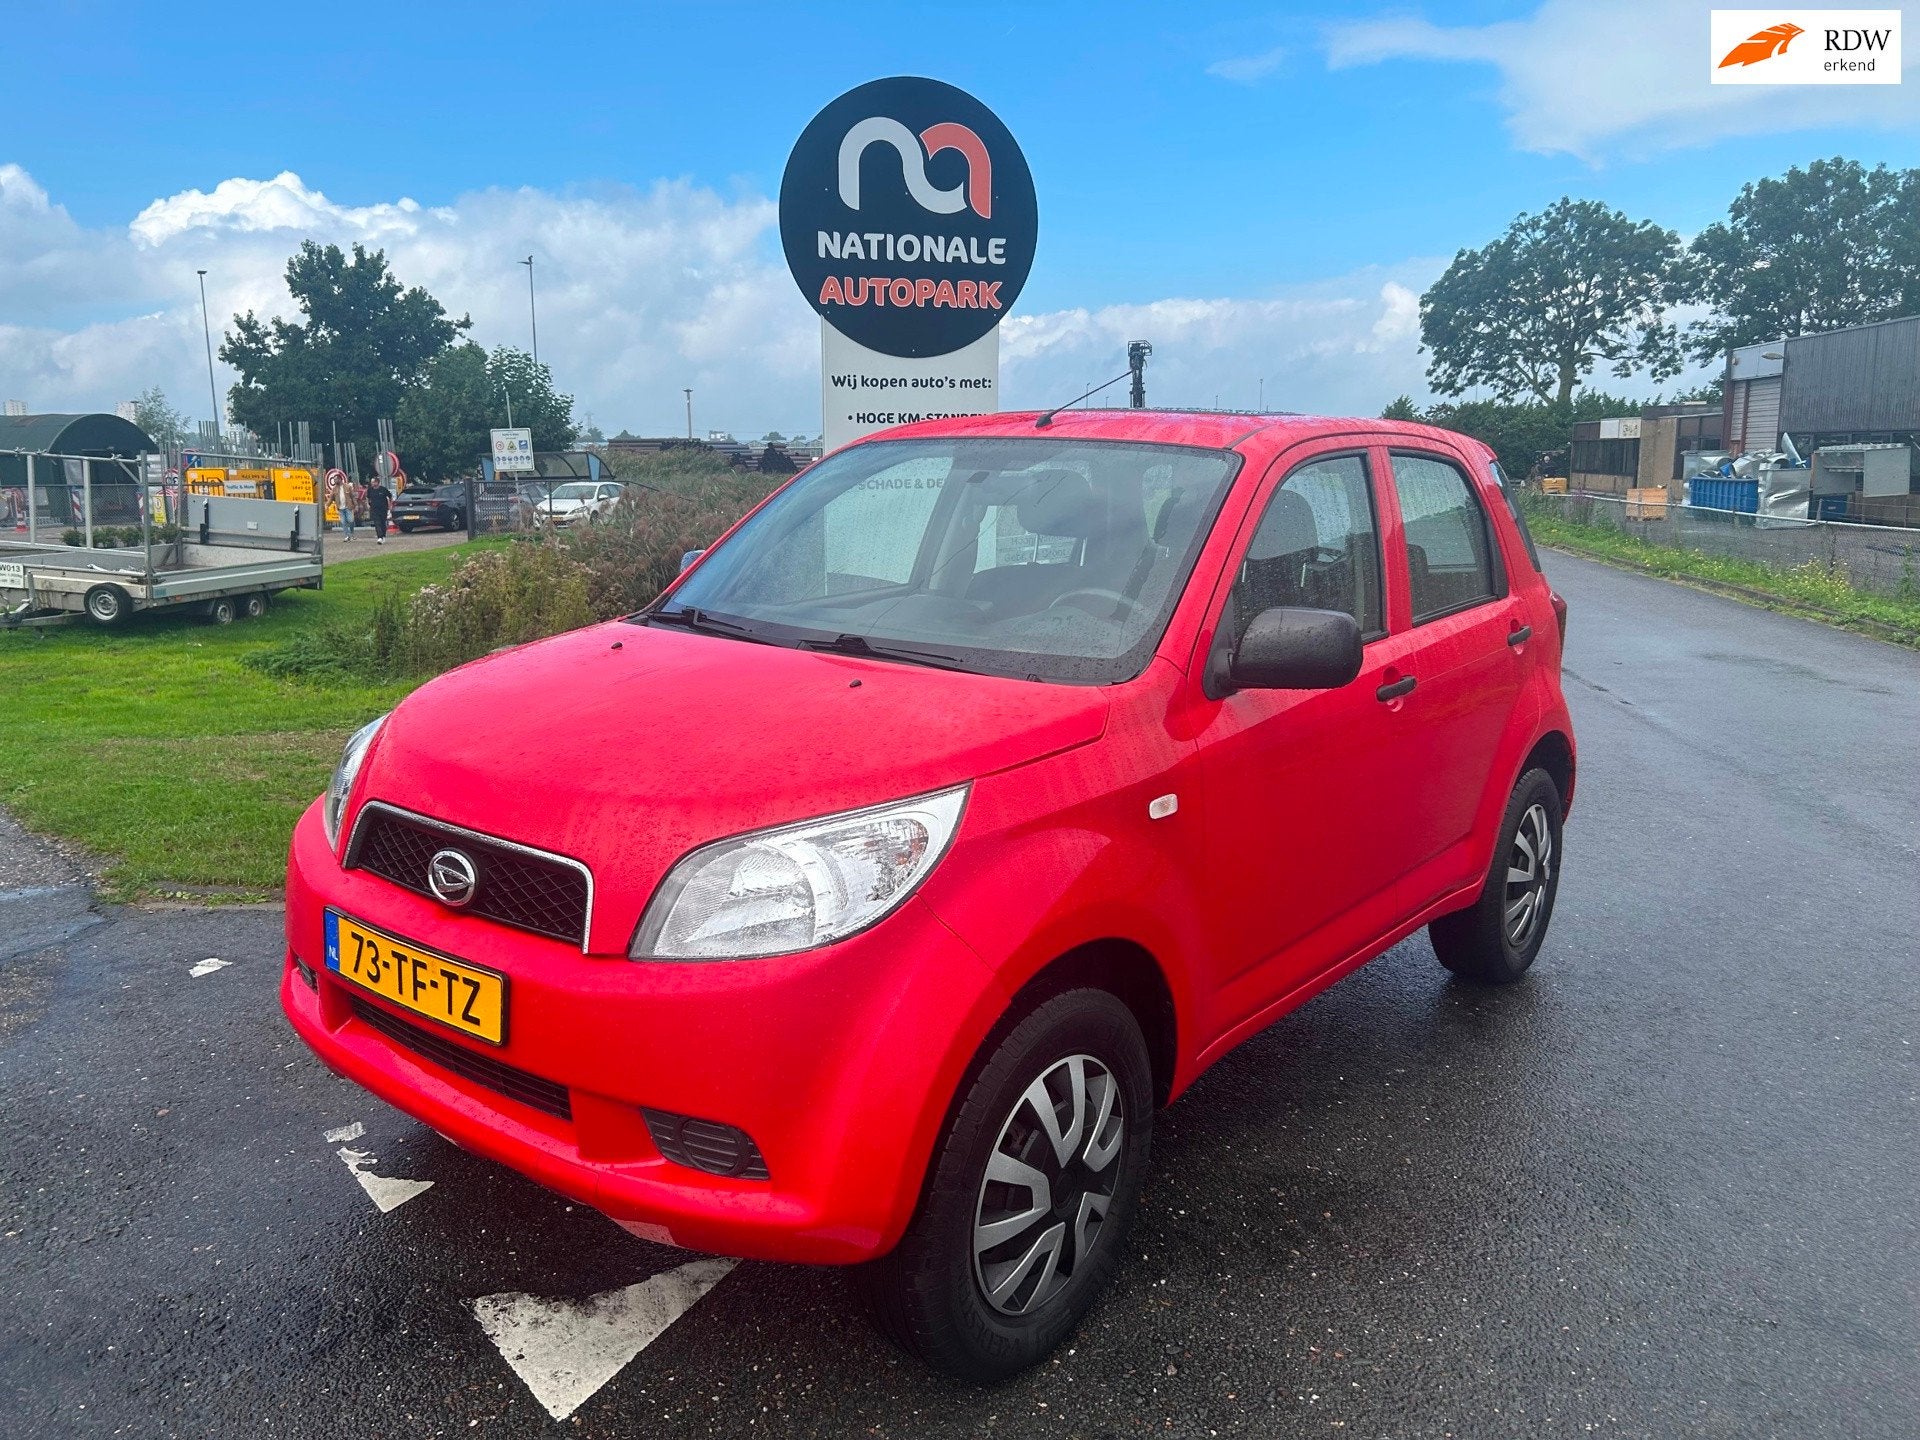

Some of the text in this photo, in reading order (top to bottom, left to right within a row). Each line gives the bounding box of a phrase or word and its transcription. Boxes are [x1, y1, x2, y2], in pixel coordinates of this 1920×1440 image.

[817, 230, 1007, 265] NATIONALE
[819, 275, 1003, 309] AUTOPARK
[831, 374, 992, 390] Wij kopen auto's met:
[856, 412, 895, 424] HOGE
[858, 478, 912, 491] SCHADE
[913, 479, 924, 490] &
[328, 944, 339, 961] NL
[351, 930, 481, 1027] 73-TF-TZ
